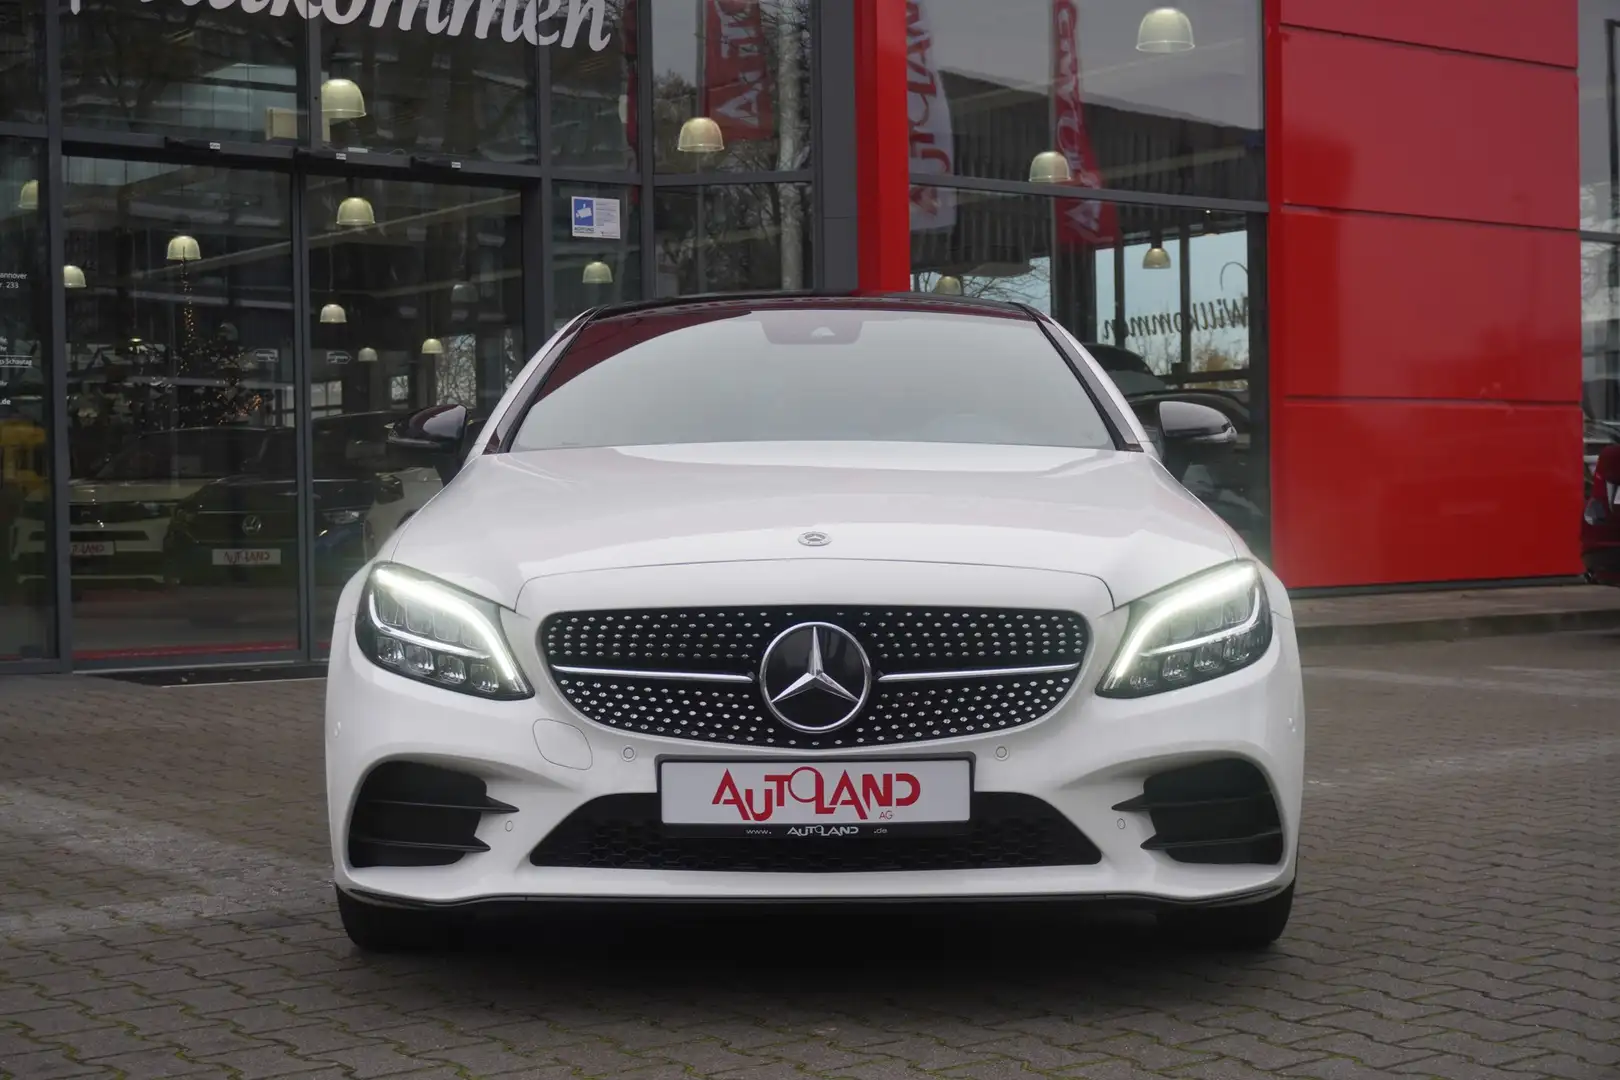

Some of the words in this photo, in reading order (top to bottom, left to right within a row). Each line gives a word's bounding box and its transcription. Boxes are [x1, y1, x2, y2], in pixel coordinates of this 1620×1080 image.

[711, 766, 921, 822] AUTOLAND
[878, 810, 894, 820] AG
[786, 824, 860, 837] AUTOLAND
